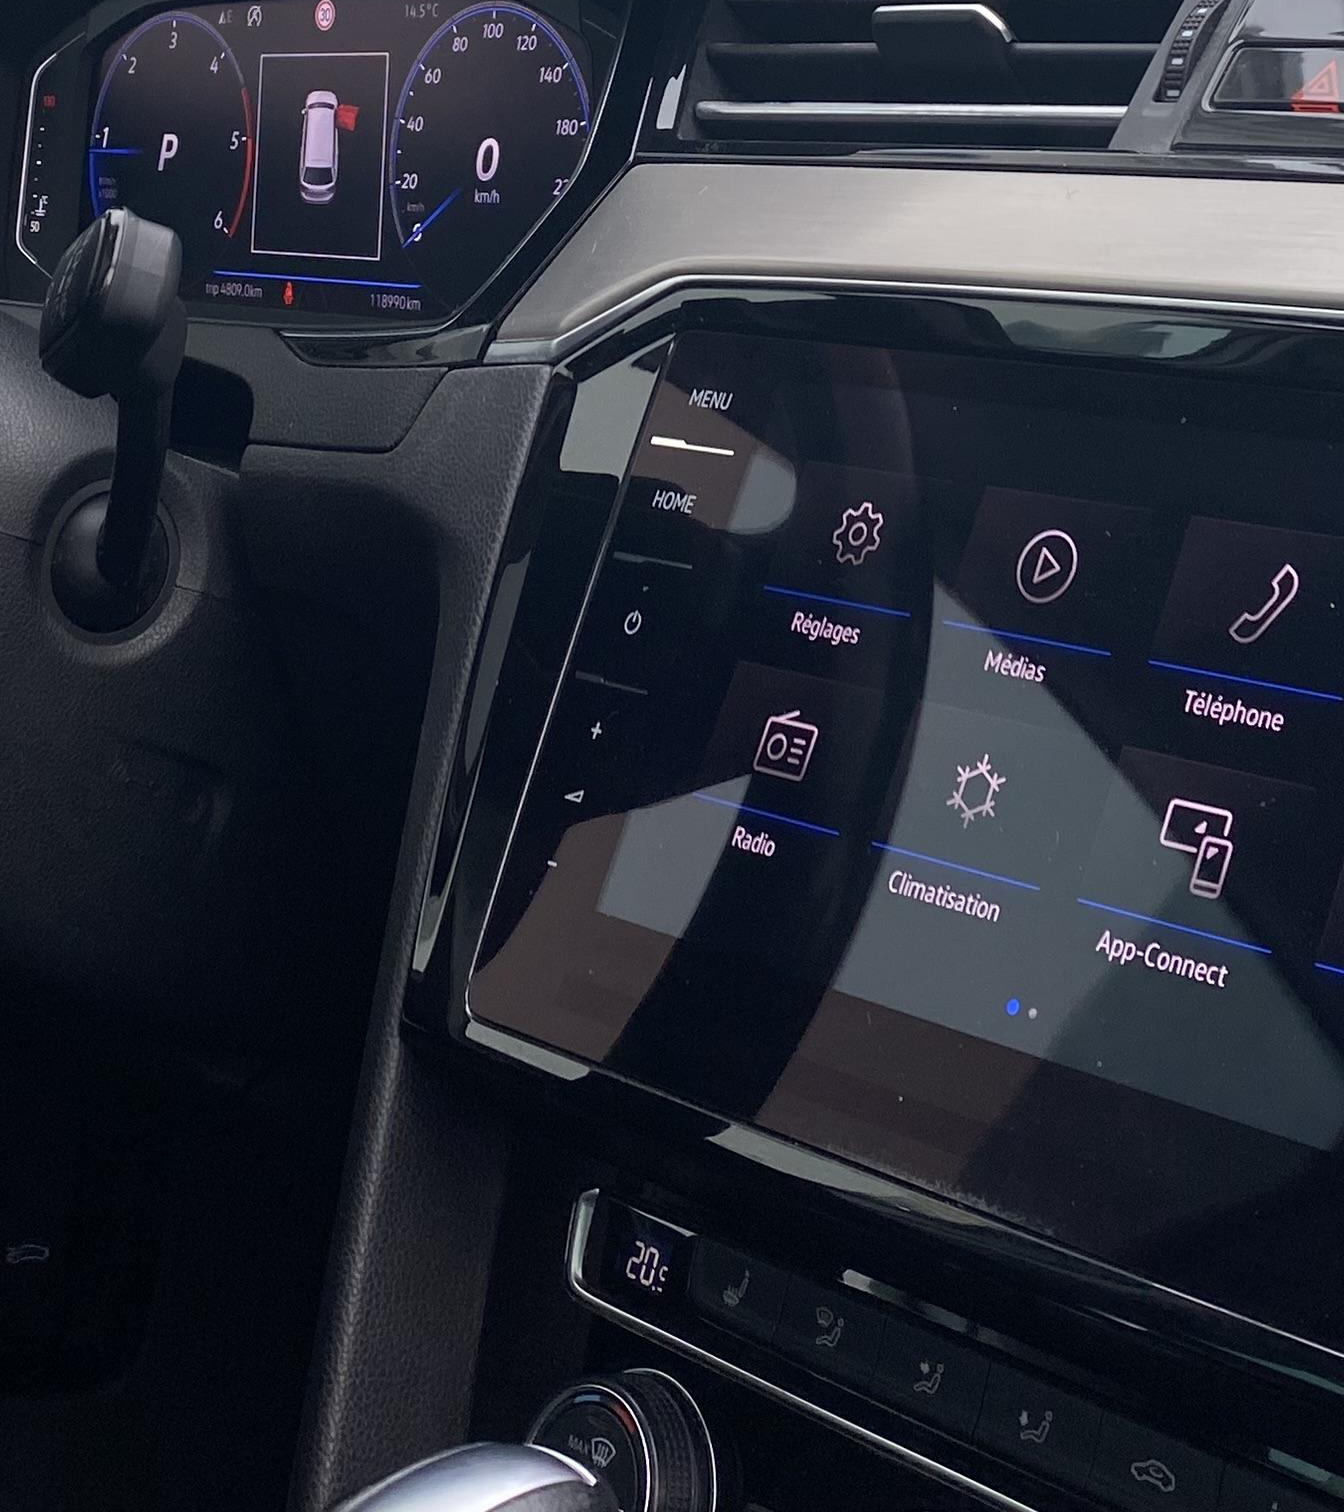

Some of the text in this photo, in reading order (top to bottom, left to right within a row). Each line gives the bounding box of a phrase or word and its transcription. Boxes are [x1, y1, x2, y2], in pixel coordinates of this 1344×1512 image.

[319, 7, 331, 23] 30
[169, 31, 178, 49] 3
[483, 23, 505, 39] 100
[452, 37, 469, 53] 80
[516, 35, 538, 51] 120
[127, 56, 137, 74] 2
[209, 56, 219, 74] 4
[424, 68, 442, 84] 60
[539, 67, 563, 84] 140
[406, 116, 424, 132] 40
[556, 119, 578, 136] 180
[102, 126, 110, 148] 1
[229, 130, 240, 150] 5
[157, 133, 179, 171] P
[476, 137, 500, 182] 0
[401, 173, 419, 190] 20
[474, 189, 500, 204] km/h
[29, 220, 41, 233] 50
[213, 210, 224, 230] 6
[689, 388, 734, 412] MENU
[651, 489, 697, 515] HOME
[790, 610, 861, 646] Réglages
[983, 648, 1046, 683] Médias
[1184, 689, 1285, 732] Téléphone
[731, 825, 776, 858] Radio
[887, 869, 1001, 923] Climatisation
[1095, 929, 1230, 988] App-Connect
